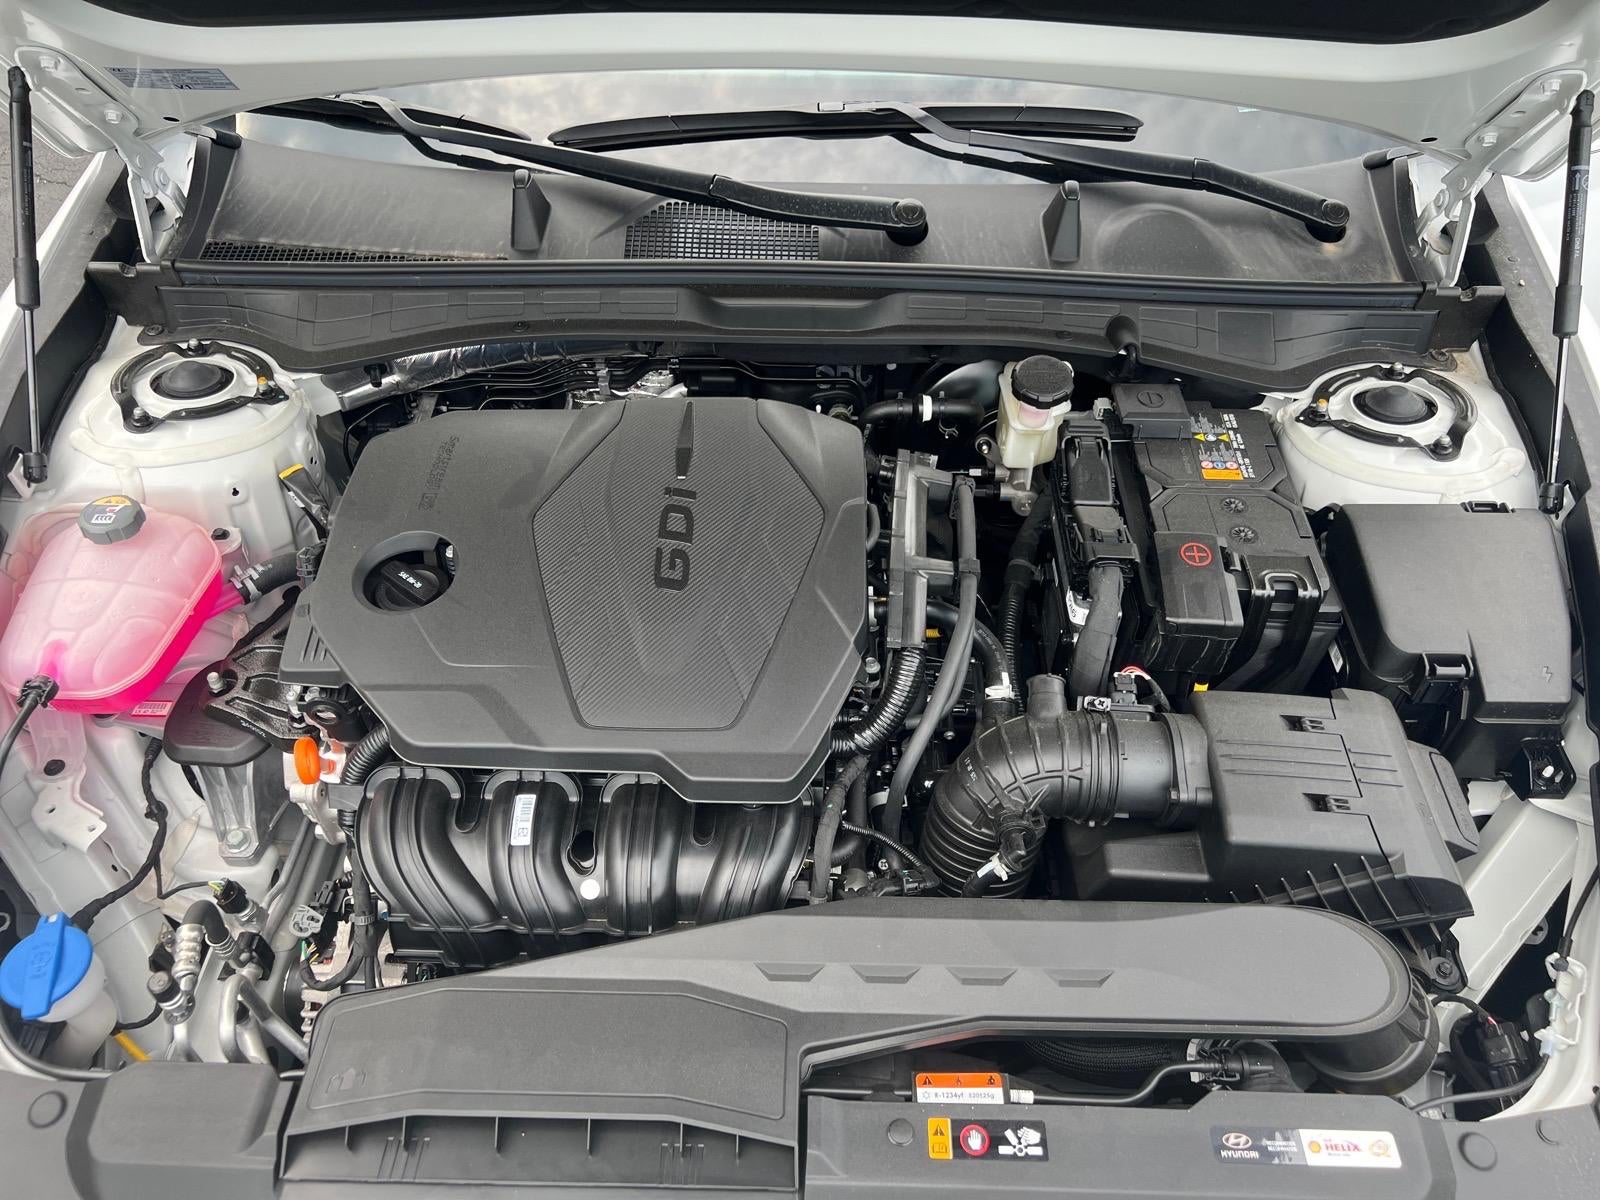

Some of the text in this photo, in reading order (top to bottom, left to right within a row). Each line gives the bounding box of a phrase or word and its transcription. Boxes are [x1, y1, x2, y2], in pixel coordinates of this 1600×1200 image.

[432, 435, 459, 489] Smartstream
[654, 486, 697, 592] GDi
[398, 571, 410, 580] SAE
[934, 1091, 964, 1099] R-1234yf
[1325, 1142, 1361, 1152] HELIX
[1220, 1149, 1259, 1159] HYUNDAI
